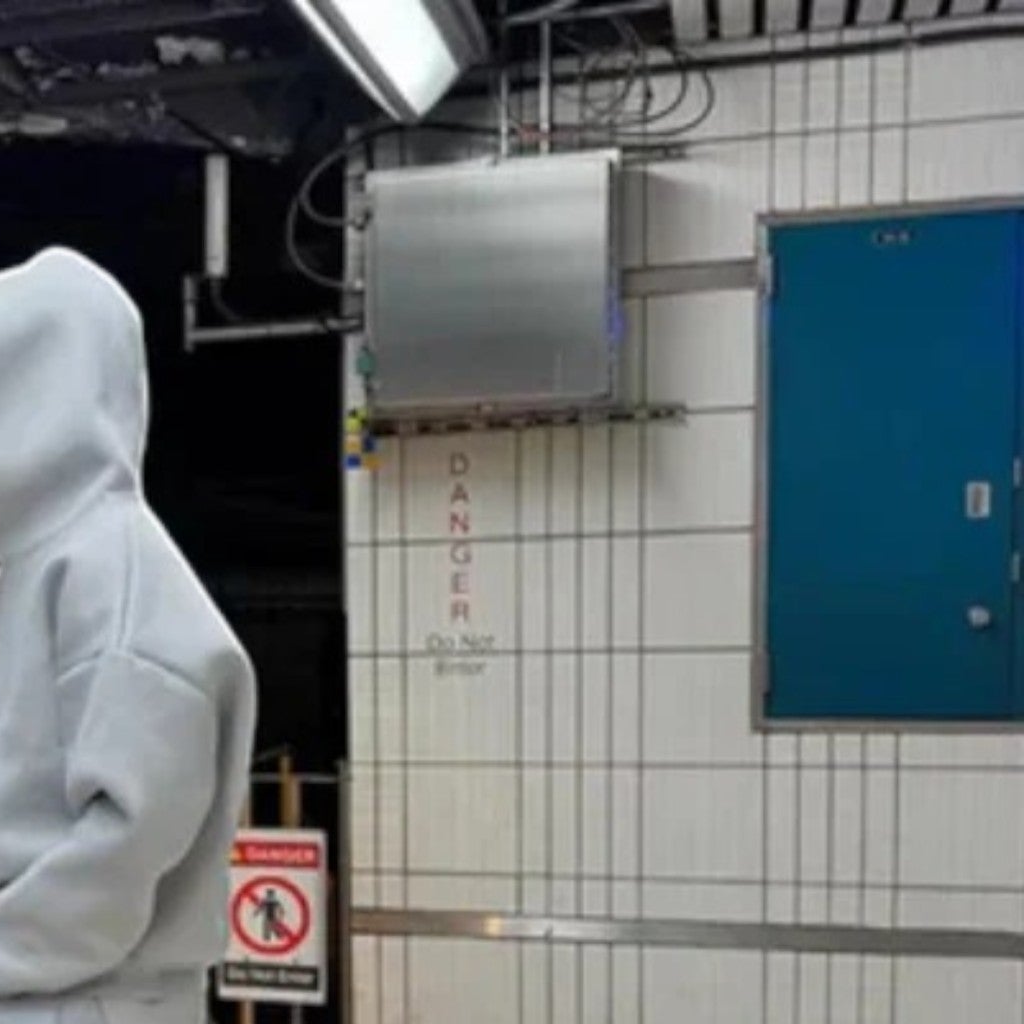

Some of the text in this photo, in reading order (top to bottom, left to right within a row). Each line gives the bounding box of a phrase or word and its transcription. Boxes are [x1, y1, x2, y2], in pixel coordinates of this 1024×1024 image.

[449, 452, 472, 622] DANGER
[427, 632, 455, 651] Do
[245, 845, 316, 864] DANGER
